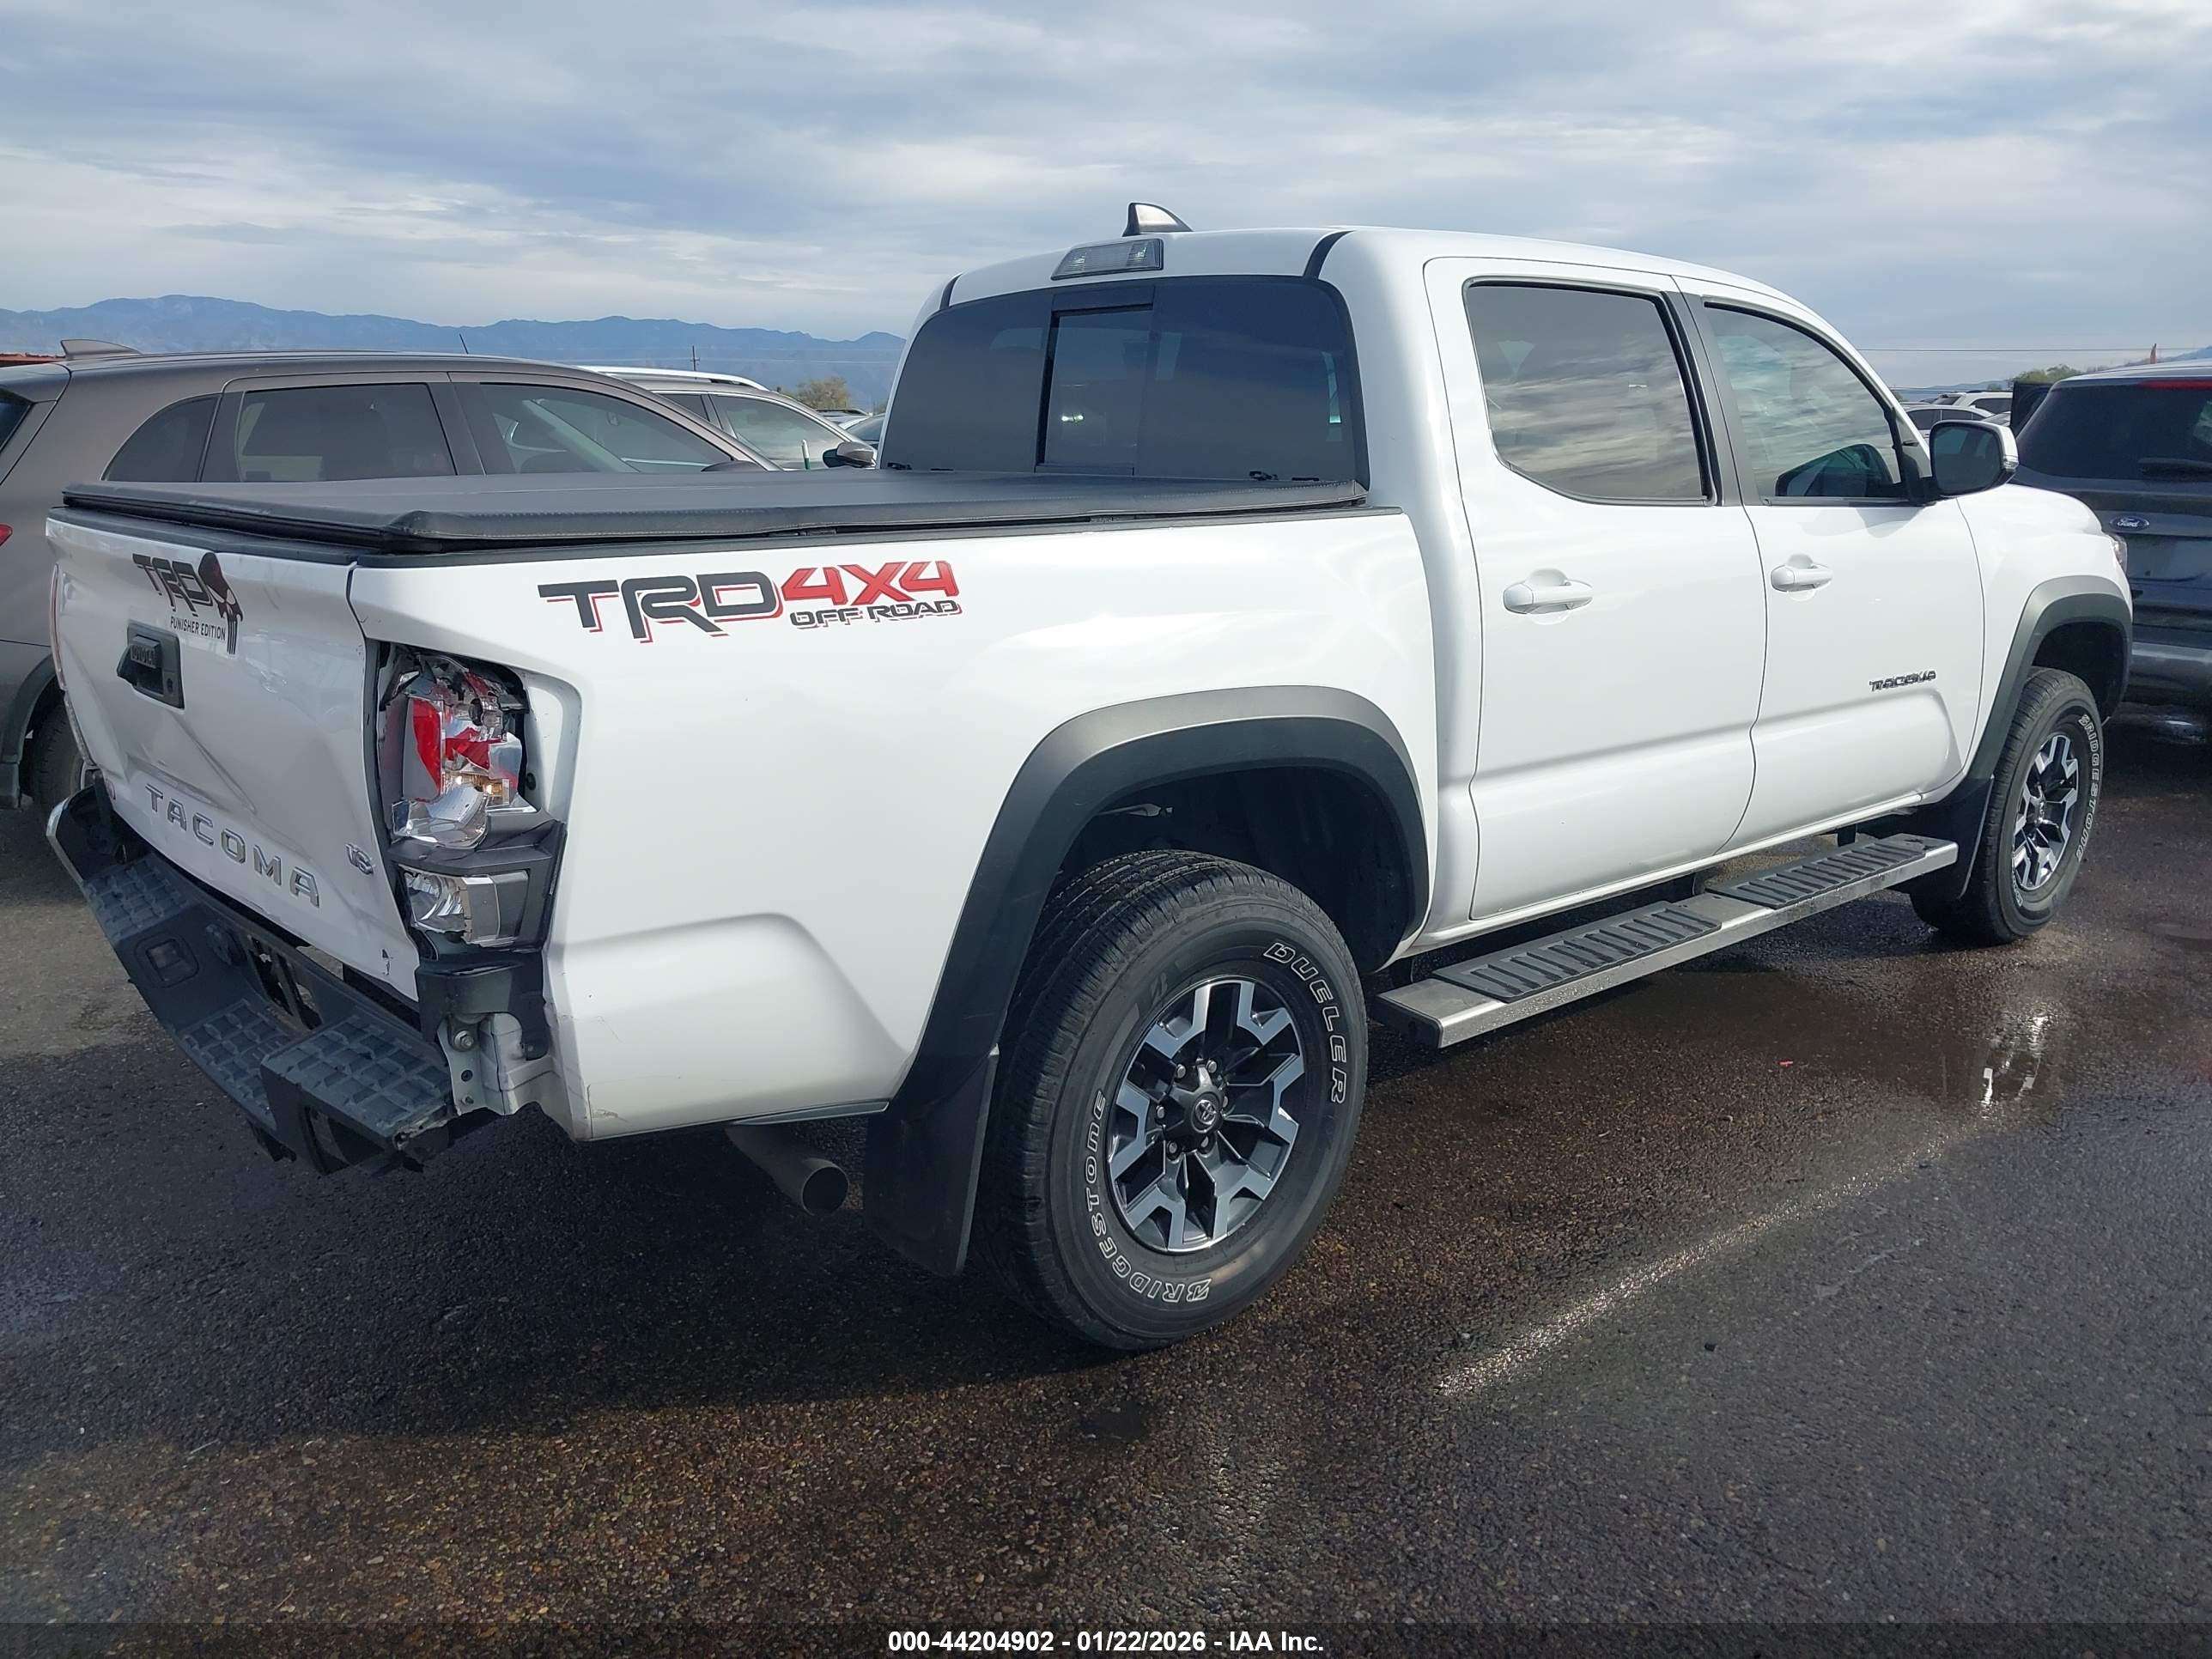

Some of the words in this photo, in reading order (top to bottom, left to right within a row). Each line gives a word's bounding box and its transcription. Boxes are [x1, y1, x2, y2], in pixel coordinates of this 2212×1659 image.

[132, 553, 214, 617] TRD
[538, 571, 784, 644] TRD
[790, 609, 864, 629] OFF
[868, 599, 963, 622] ROAD
[170, 616, 200, 635] PUNISHER
[201, 623, 226, 641] EDITION
[1869, 670, 1936, 691] TACOMA
[2075, 714, 2100, 862] BRIDGESTONE
[145, 783, 320, 908] TACOMA
[345, 843, 374, 875] V6
[1263, 941, 1348, 1105] DUELER
[1085, 1090, 1212, 1304] BRIDGESTONE
